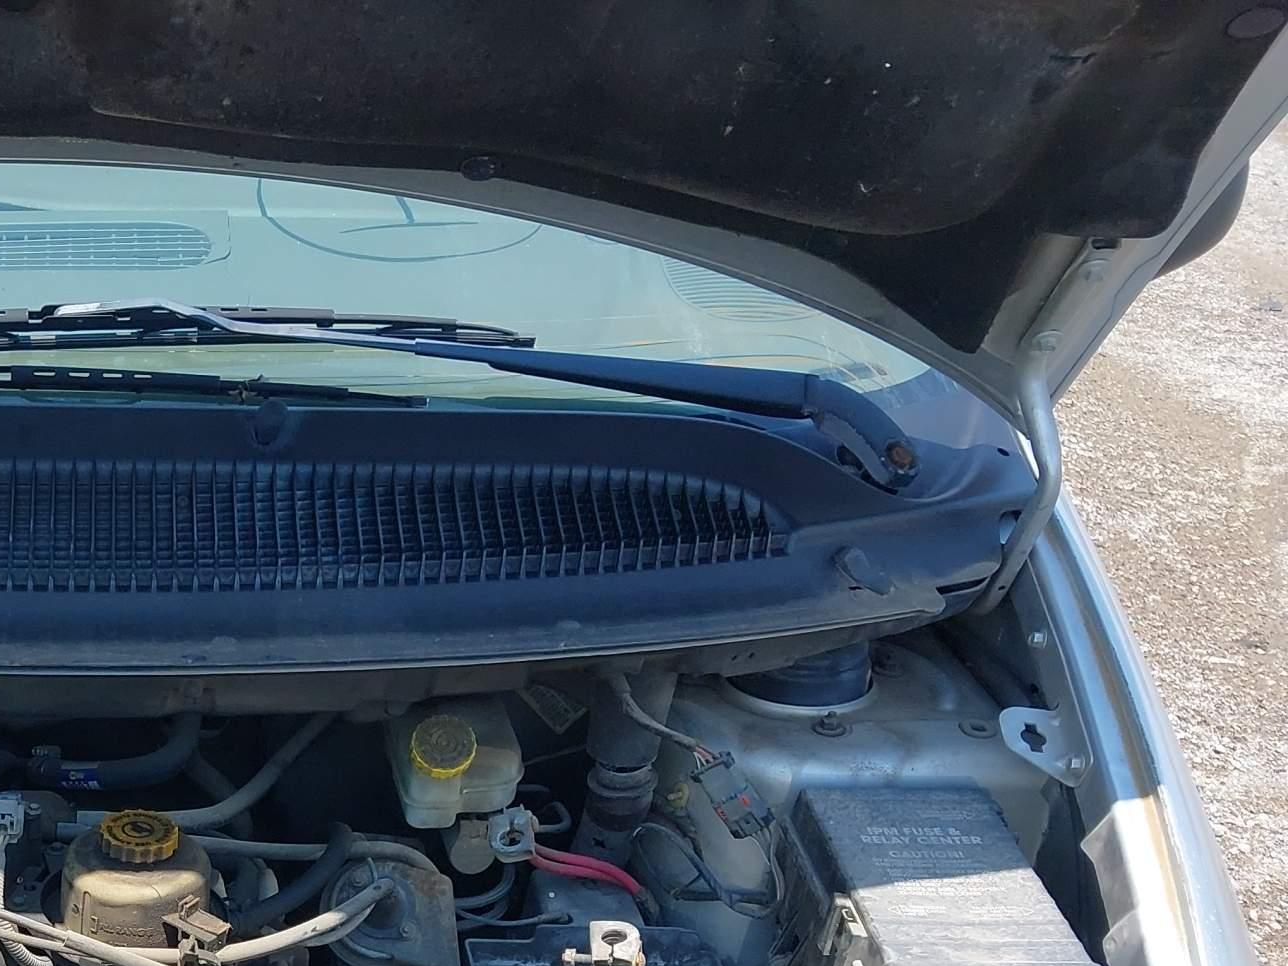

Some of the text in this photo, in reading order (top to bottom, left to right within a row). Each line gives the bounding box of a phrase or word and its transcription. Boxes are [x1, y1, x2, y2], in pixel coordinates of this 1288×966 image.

[903, 826, 944, 836] FUSE
[860, 834, 983, 845] RELAY CENTER
